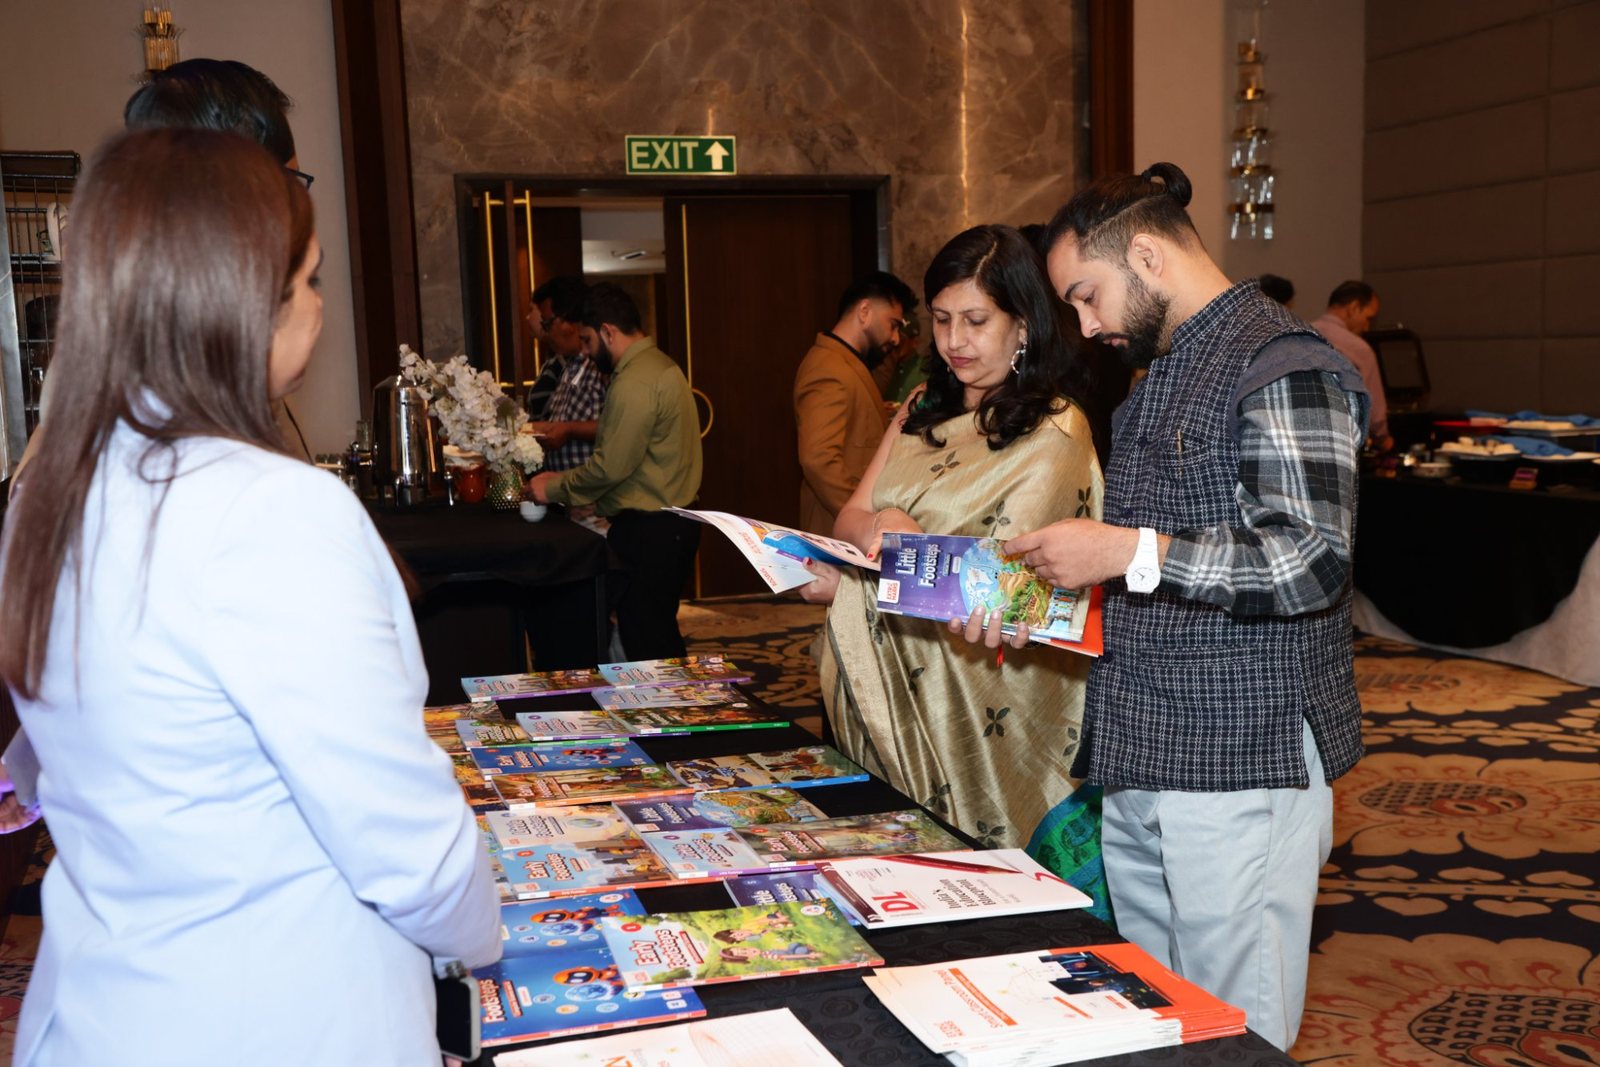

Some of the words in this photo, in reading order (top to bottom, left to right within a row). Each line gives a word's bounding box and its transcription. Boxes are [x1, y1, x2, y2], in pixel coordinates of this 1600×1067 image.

[631, 141, 699, 169] EXIT
[895, 547, 917, 576] Little
[918, 543, 939, 588] Footsteps
[629, 940, 661, 966] Early
[655, 929, 690, 969] Footsteps
[480, 978, 507, 1023] Footsteps
